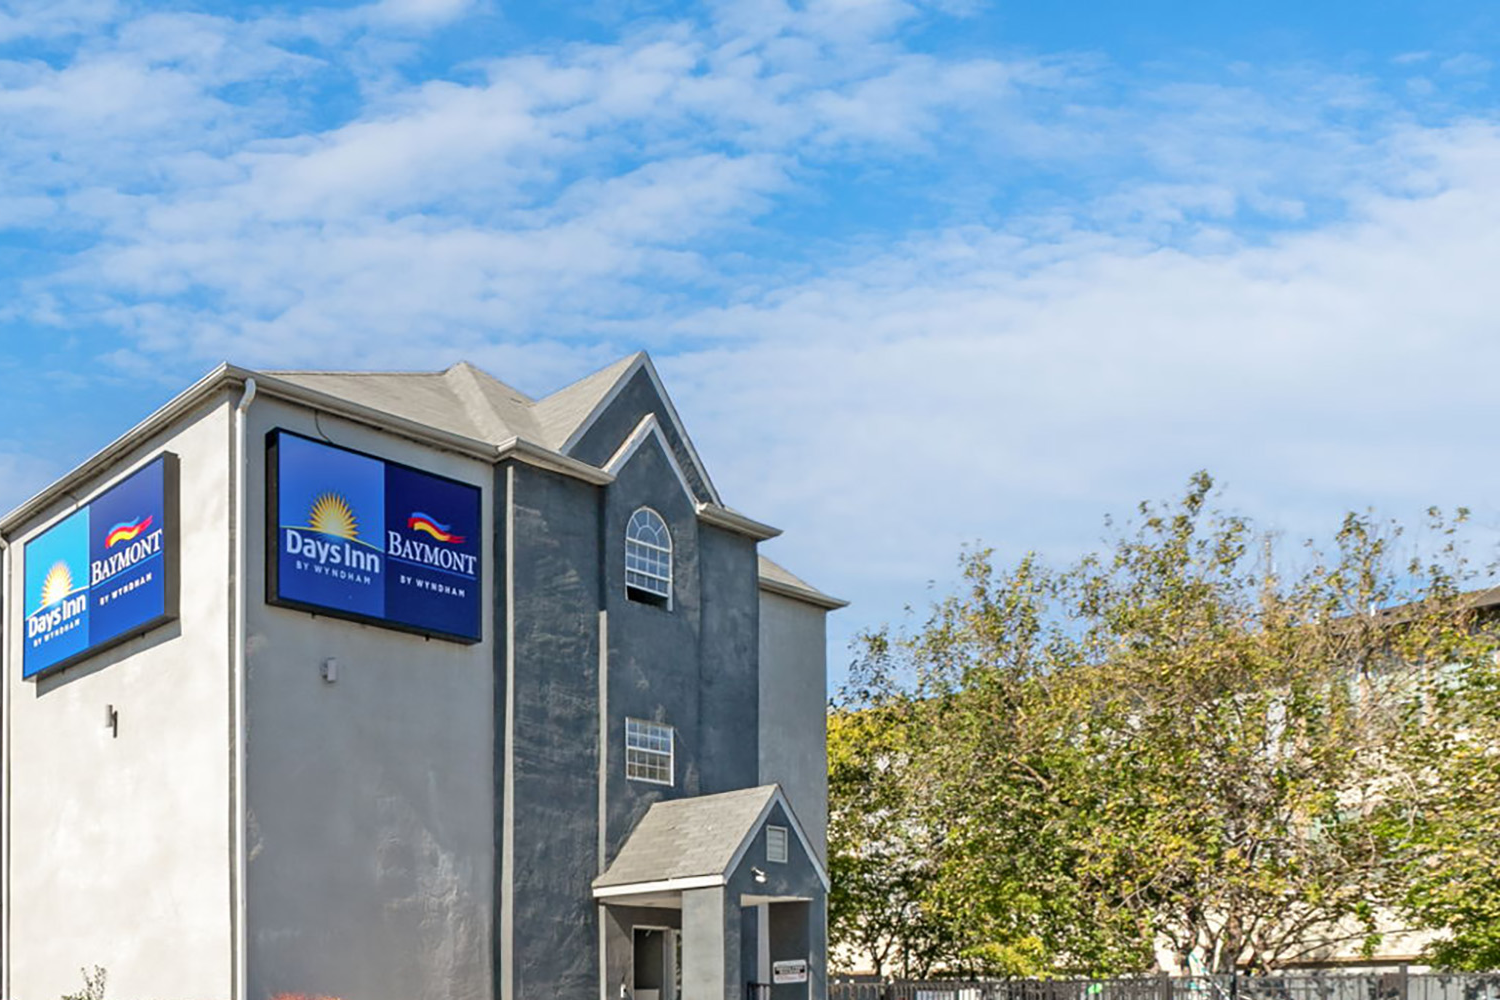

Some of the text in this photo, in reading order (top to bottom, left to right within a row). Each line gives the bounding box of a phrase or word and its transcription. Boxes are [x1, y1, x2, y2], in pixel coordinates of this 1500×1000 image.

[91, 528, 163, 586] BAYMONT
[388, 530, 477, 575] BAYMONT
[296, 560, 371, 585] BY WYNDHAM
[400, 575, 466, 598] BY WYNDHAM
[100, 572, 152, 606] BY WYNDHAM
[33, 619, 80, 647] BY WYNDHAM
